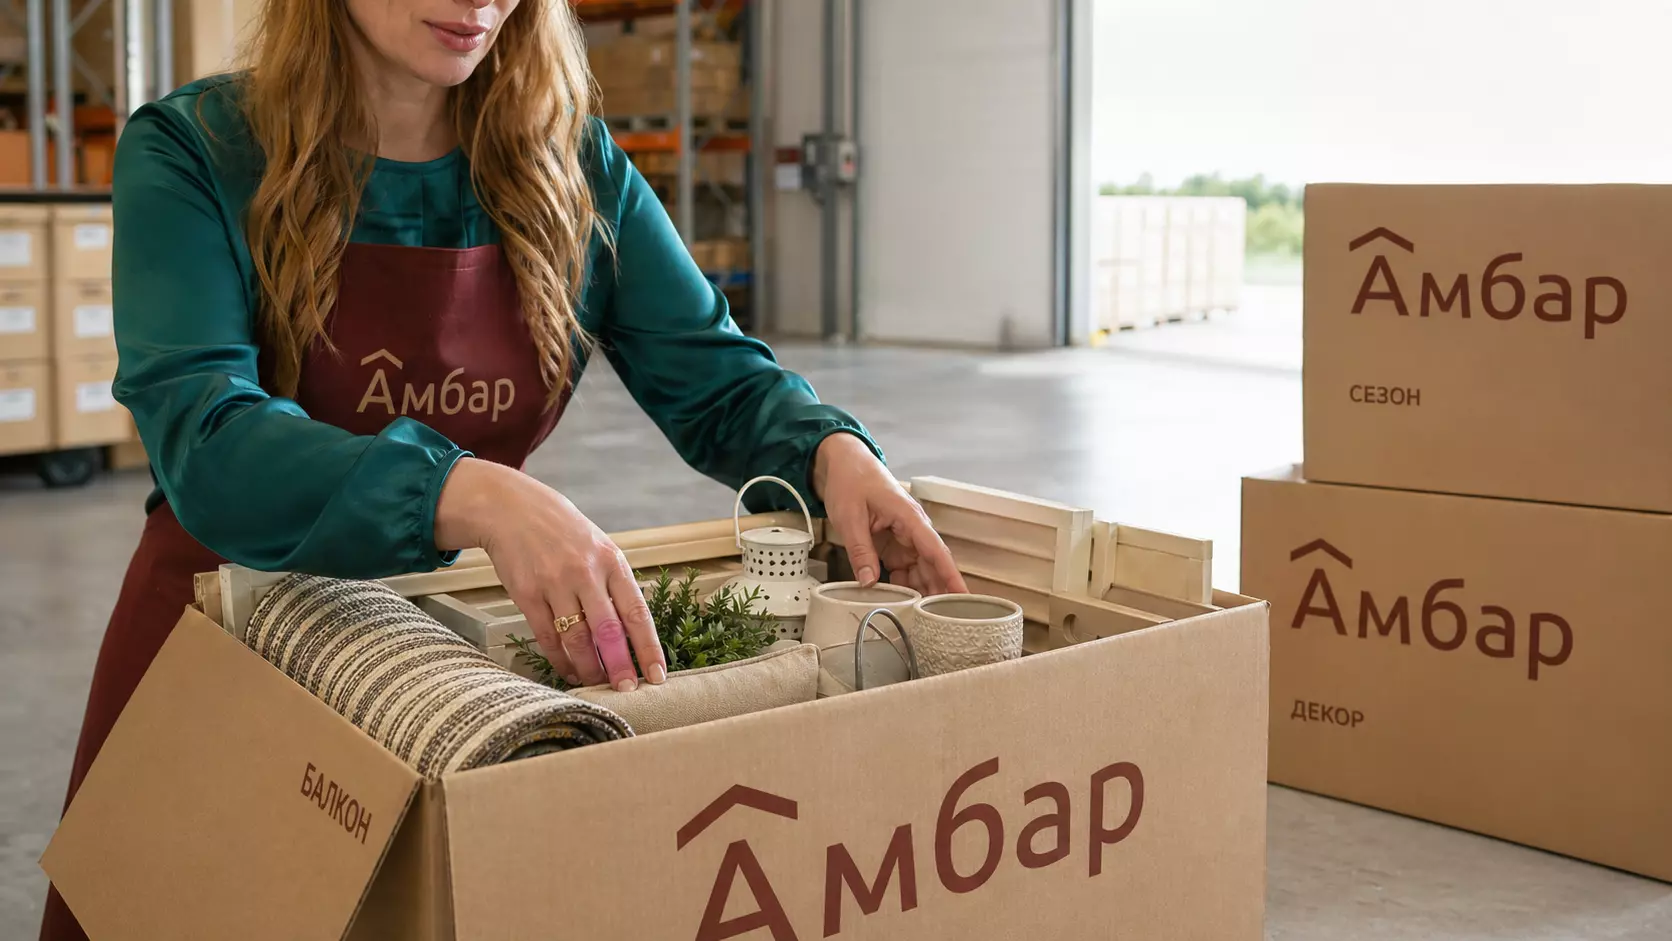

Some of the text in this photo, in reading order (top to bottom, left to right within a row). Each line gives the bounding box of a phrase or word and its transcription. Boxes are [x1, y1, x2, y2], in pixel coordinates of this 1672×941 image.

[1351, 252, 1628, 340] Амбар
[357, 366, 516, 423] Амбар
[1349, 384, 1421, 407] СЕЗОН
[1291, 568, 1574, 682] Амбар
[1290, 699, 1365, 729] ДЕКОР
[300, 761, 373, 845] БАЛКОН
[694, 756, 1144, 941] Амбар
